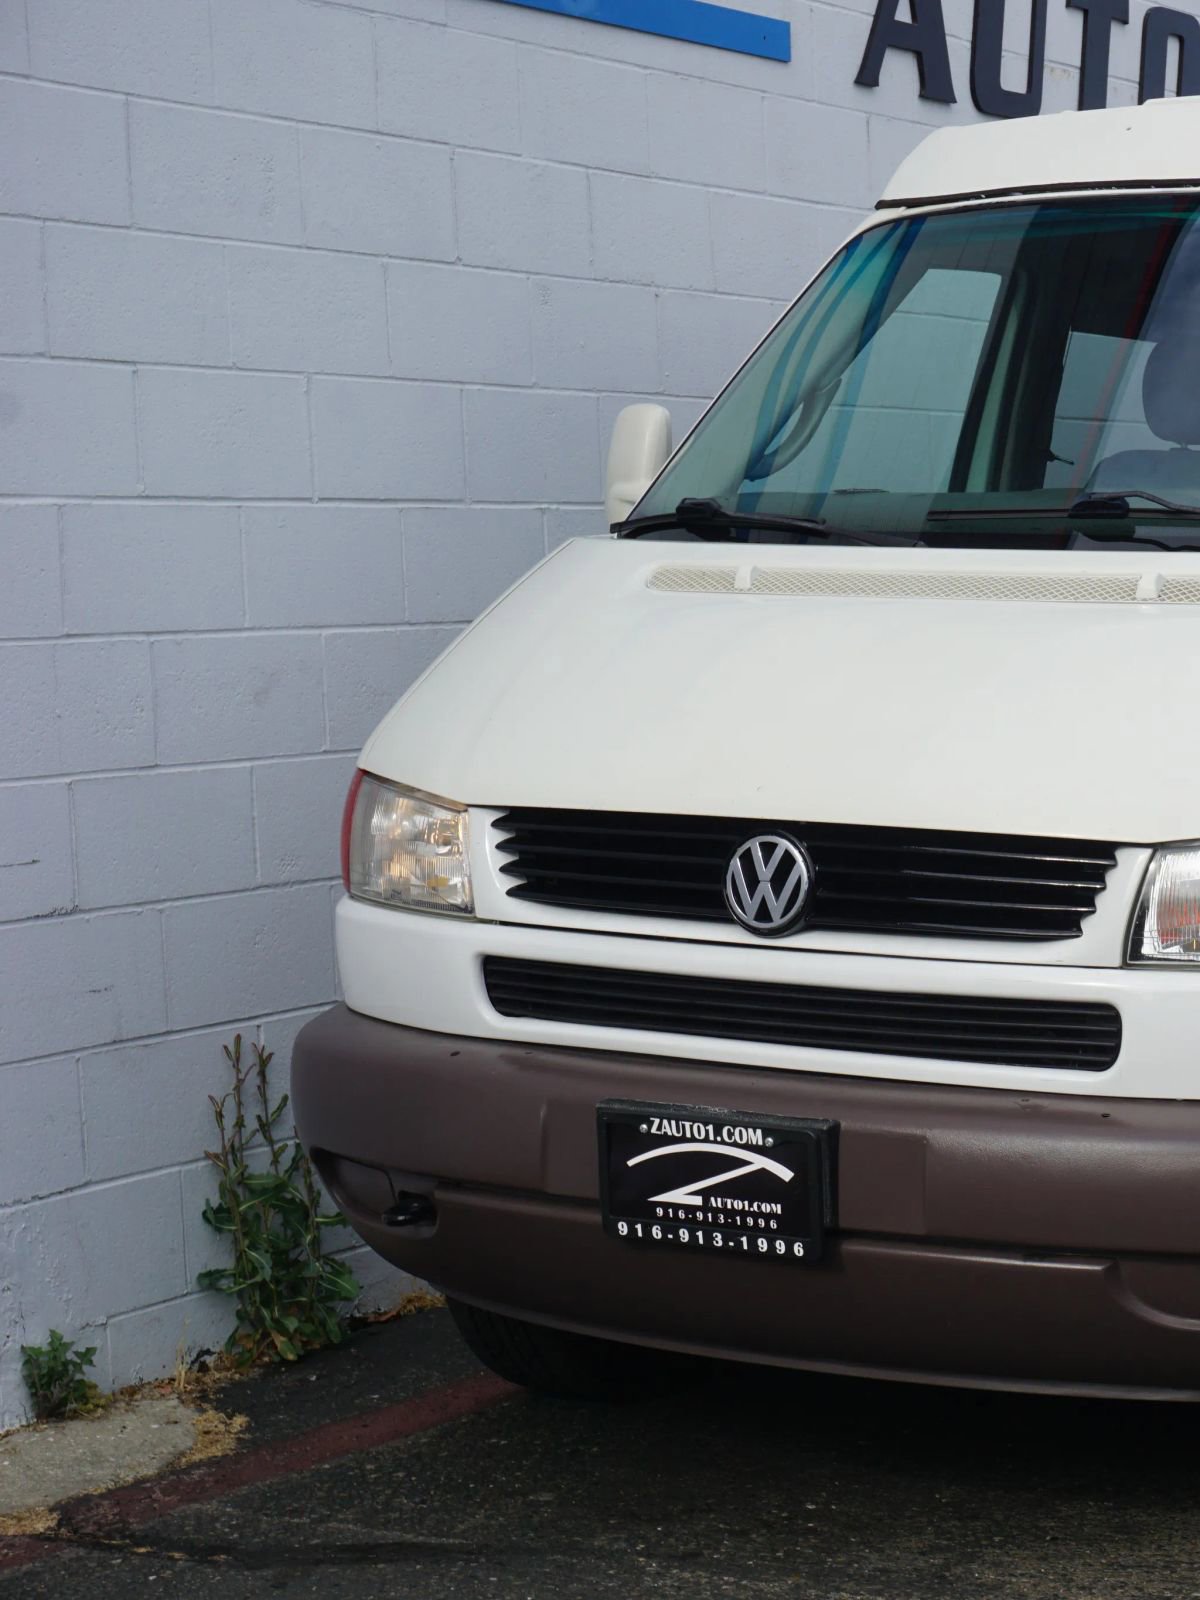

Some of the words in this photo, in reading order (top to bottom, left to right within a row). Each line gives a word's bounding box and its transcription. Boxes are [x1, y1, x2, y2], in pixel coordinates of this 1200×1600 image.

[650, 1117, 763, 1146] ZAUTO1.COM
[656, 1206, 778, 1230] 916-913-1996
[708, 1196, 782, 1215] AUTO1.COM
[617, 1221, 805, 1257] 916-913-1996
